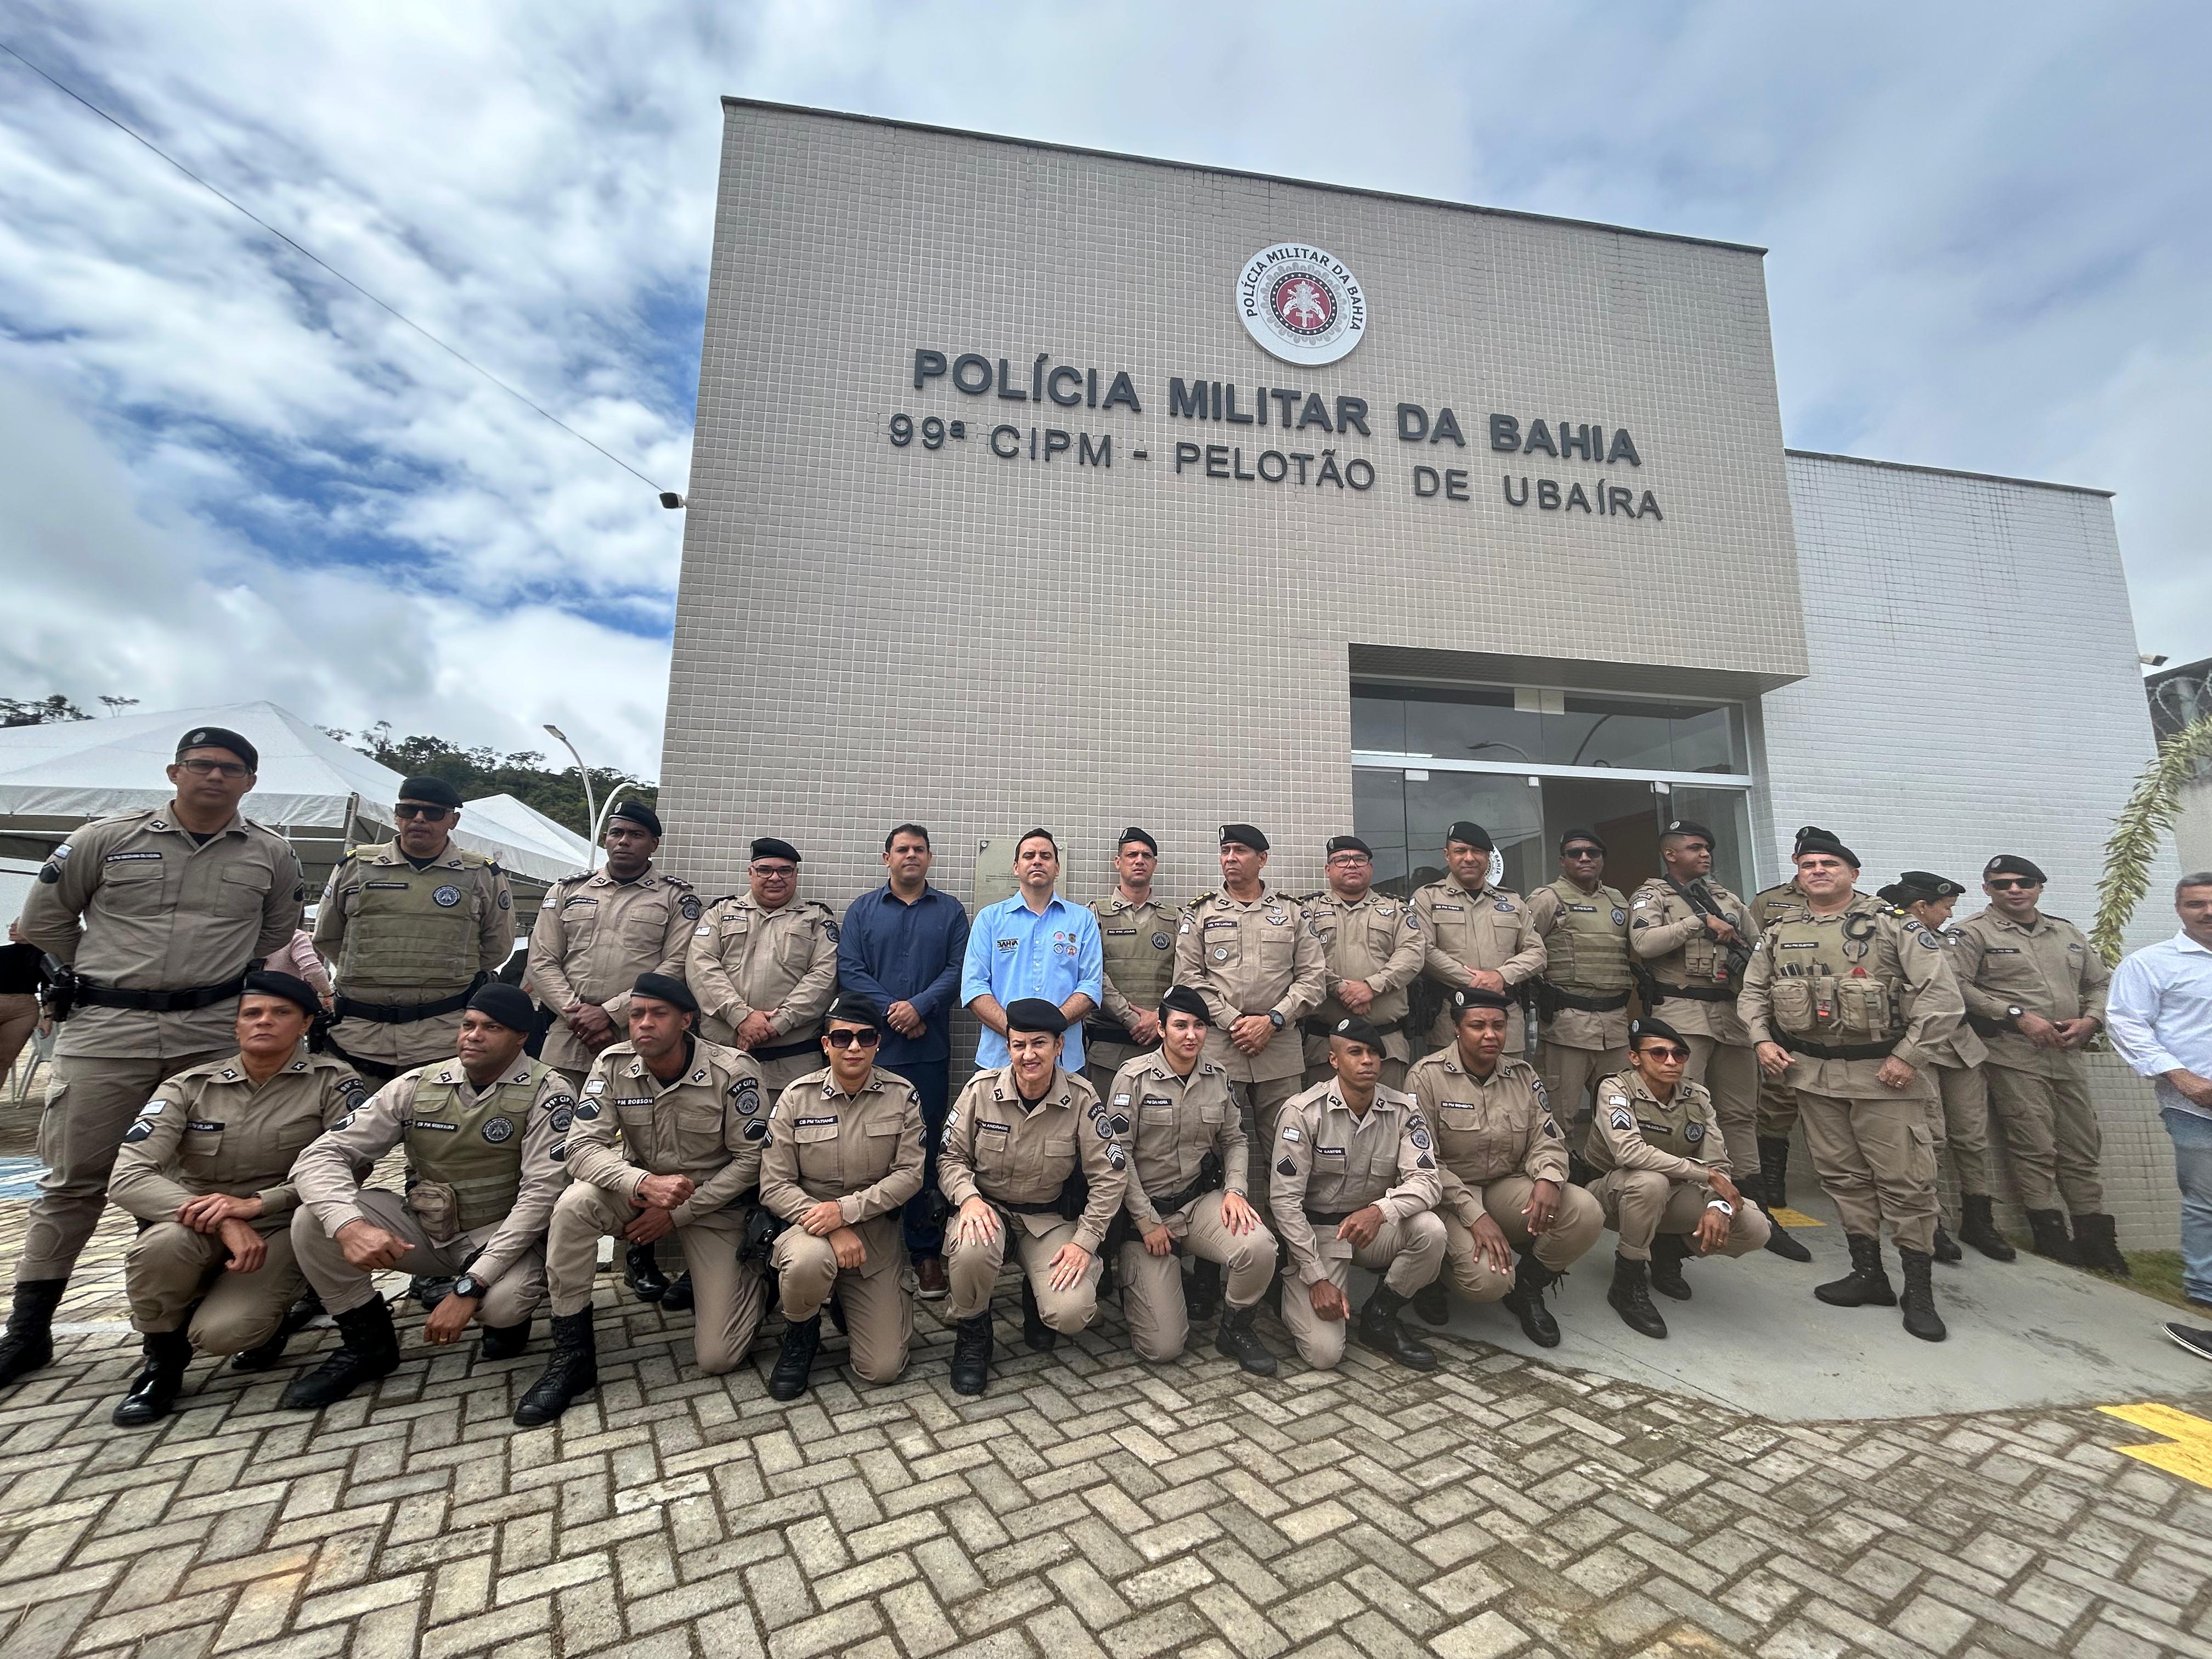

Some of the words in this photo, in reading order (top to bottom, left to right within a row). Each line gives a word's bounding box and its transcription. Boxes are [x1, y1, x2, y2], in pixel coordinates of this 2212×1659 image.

[1241, 261, 1268, 317] POLÍCIA
[1266, 247, 1330, 267] MILITAR
[1331, 264, 1350, 284] DA
[1347, 286, 1363, 330] BAHIA
[914, 348, 1142, 412] POLÍCIA
[1170, 376, 1371, 436] MILITAR
[1397, 402, 1466, 447] DA
[1489, 413, 1642, 466] BAHIA
[890, 413, 965, 449] 99ª
[991, 424, 1111, 467] CIPM
[1176, 441, 1375, 490] PELOTÃO
[1414, 465, 1470, 501] DE
[1504, 475, 1663, 521] UBAÍRA
